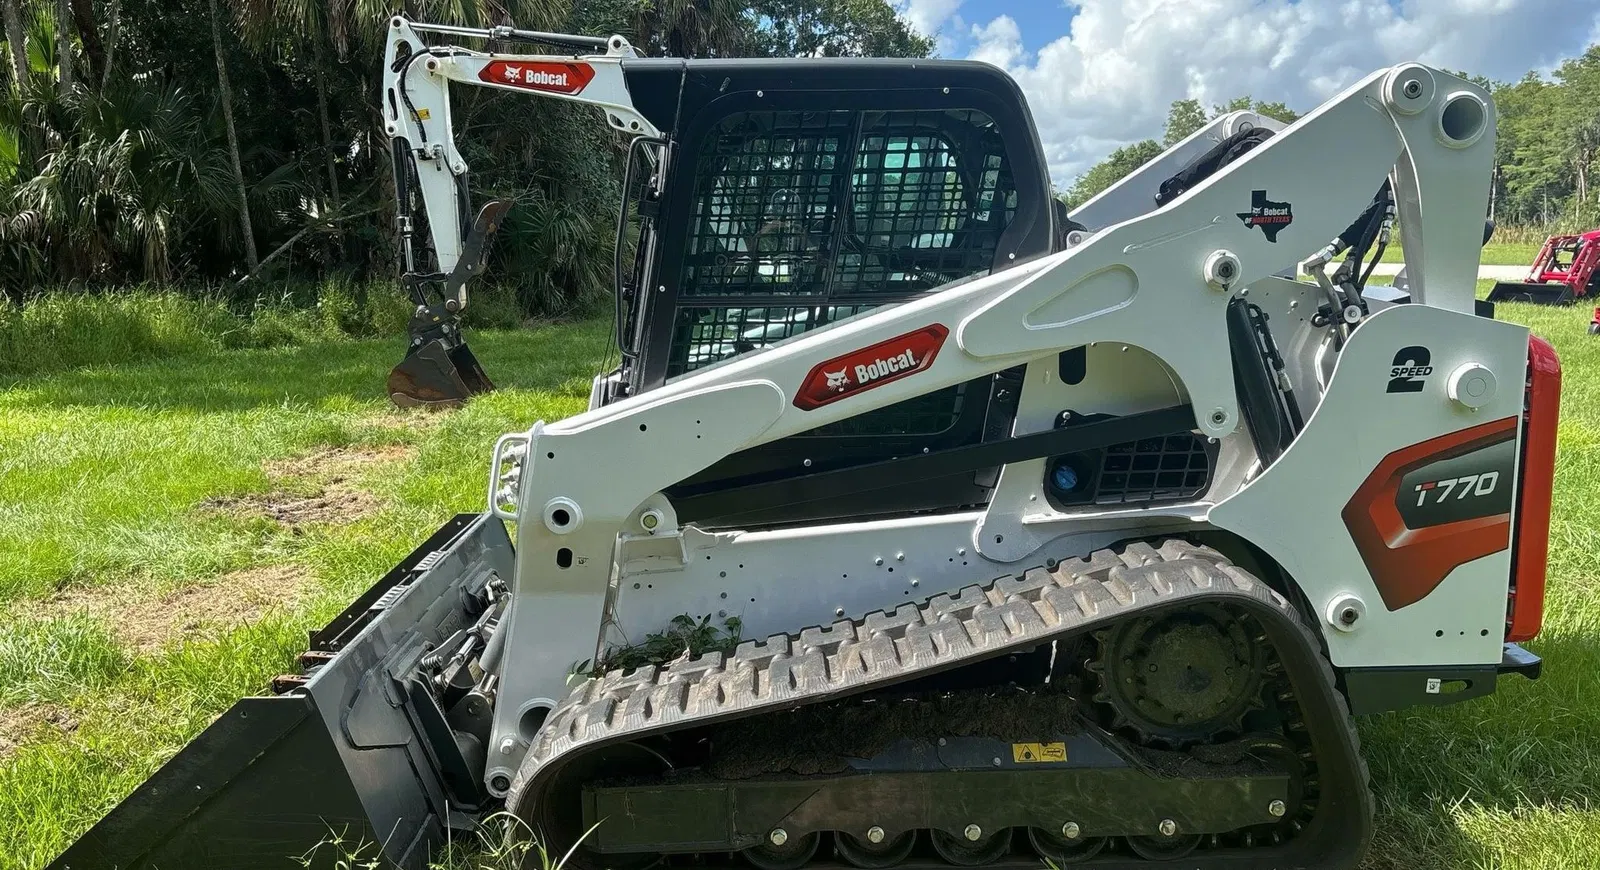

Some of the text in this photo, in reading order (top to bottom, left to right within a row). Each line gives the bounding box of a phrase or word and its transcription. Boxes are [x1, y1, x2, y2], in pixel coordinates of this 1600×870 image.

[525, 69, 568, 86] Bobcat
[1252, 216, 1272, 224] NORTH
[1272, 215, 1290, 223] TEXAS
[1263, 207, 1288, 216] Bobcat
[854, 348, 917, 384] Bobcat
[1386, 345, 1431, 394] 2
[1390, 366, 1433, 377] SPEED
[1415, 471, 1499, 507] T770
